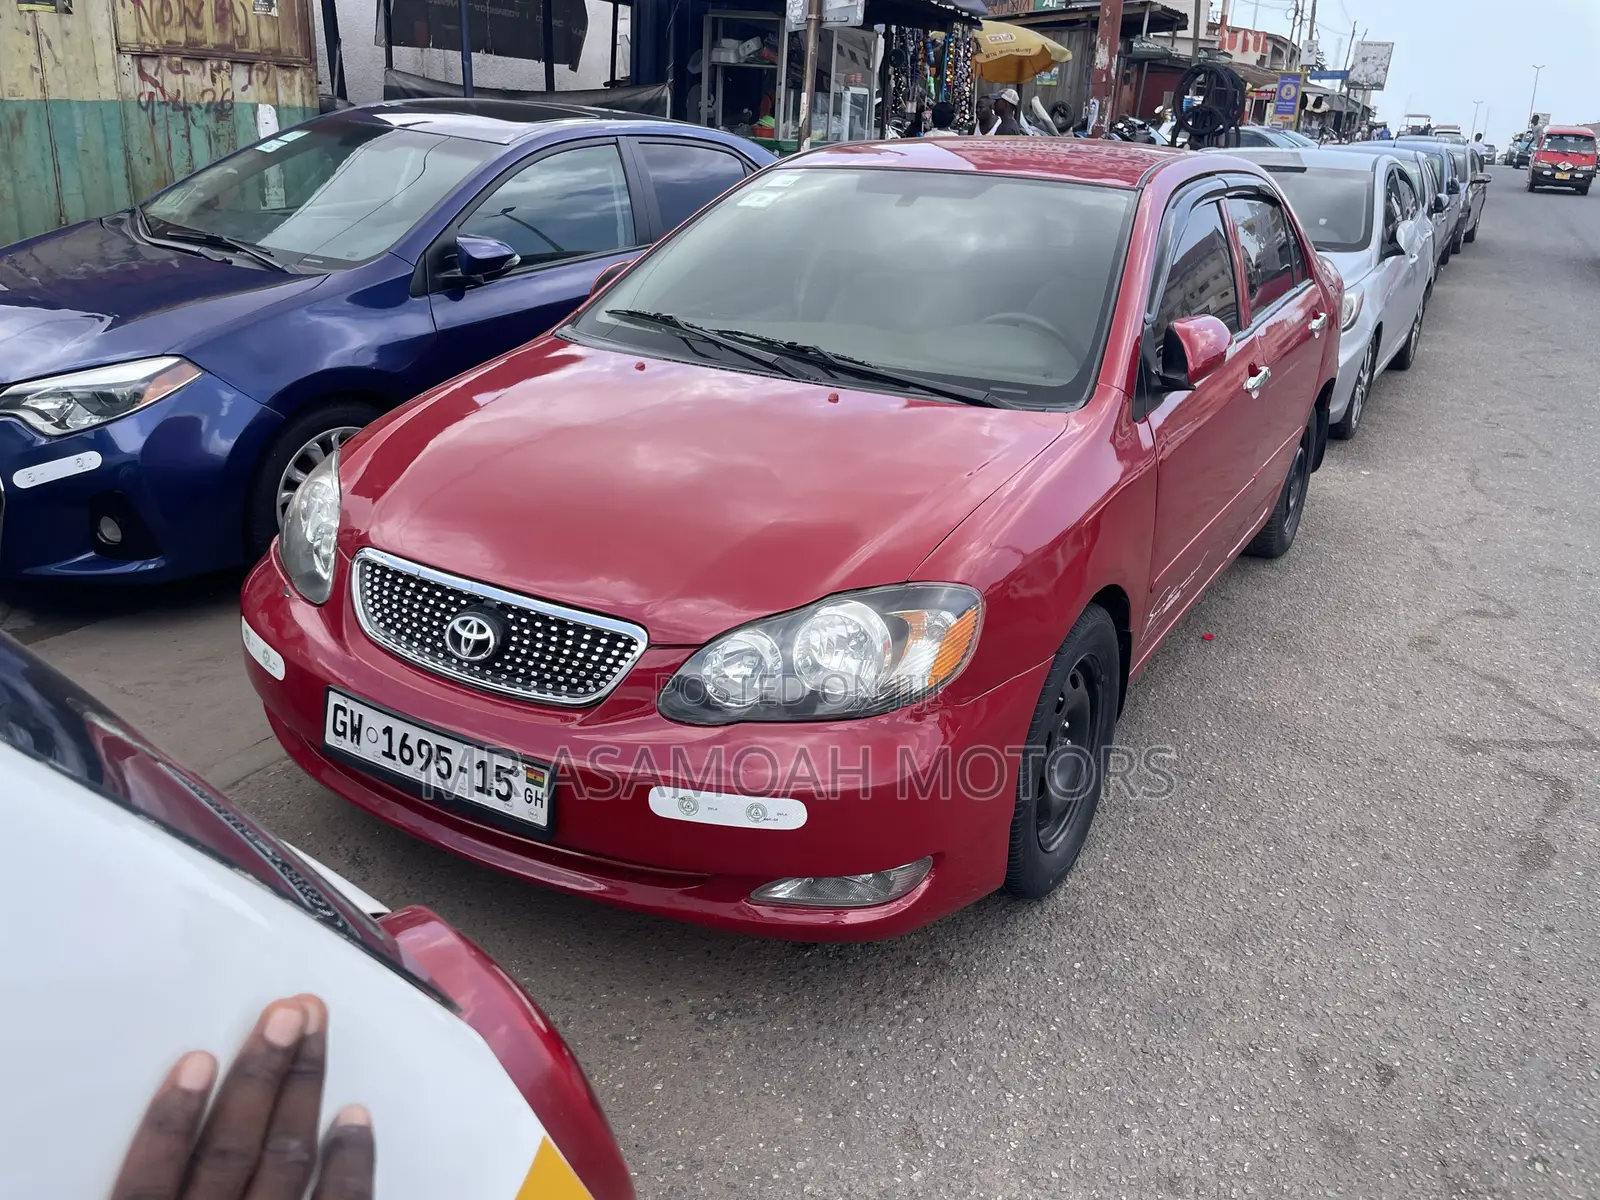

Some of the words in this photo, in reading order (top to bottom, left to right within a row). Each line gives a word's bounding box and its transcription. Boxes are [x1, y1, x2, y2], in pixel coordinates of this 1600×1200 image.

[985, 51, 998, 59] MTN
[332, 703, 363, 746] GW
[381, 725, 520, 802] 1695-15
[524, 787, 545, 808] GH
